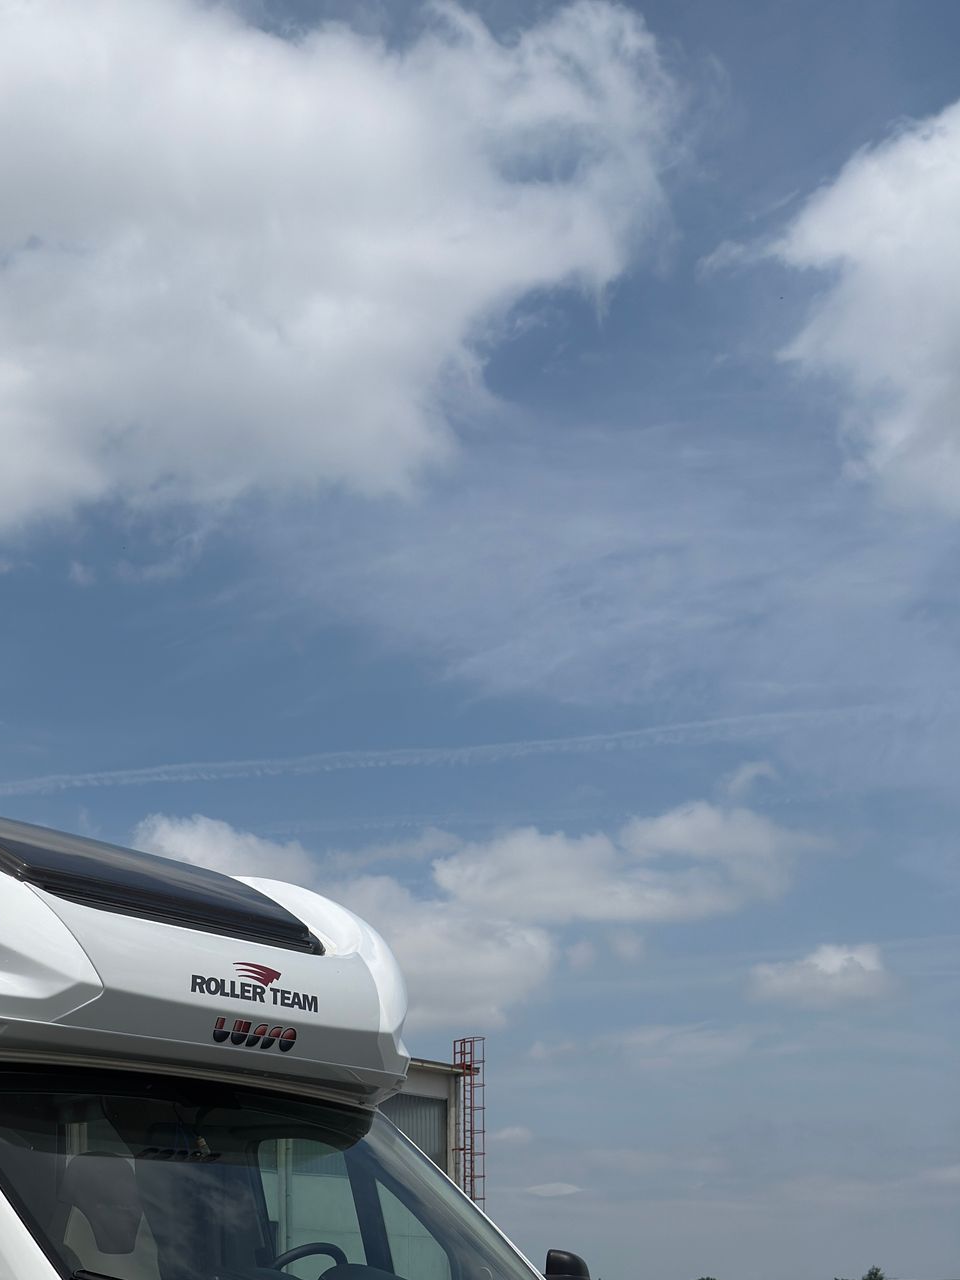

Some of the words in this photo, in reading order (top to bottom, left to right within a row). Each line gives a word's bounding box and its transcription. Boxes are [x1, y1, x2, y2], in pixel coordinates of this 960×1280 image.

[190, 974, 266, 1003] ROLLER
[269, 987, 319, 1013] TEAM
[212, 1016, 297, 1052] LUSSO
